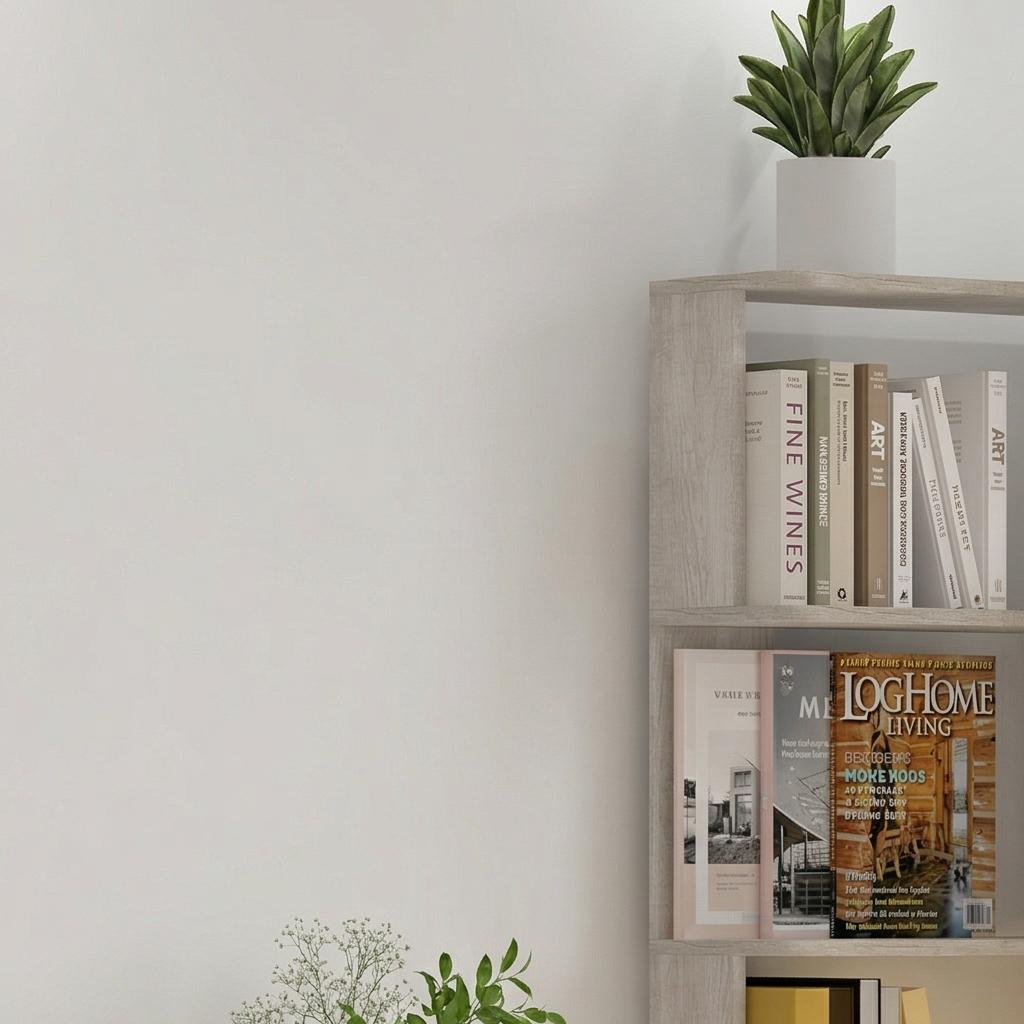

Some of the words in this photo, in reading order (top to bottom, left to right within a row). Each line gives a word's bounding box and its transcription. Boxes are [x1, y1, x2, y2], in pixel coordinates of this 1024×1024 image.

[785, 402, 804, 466] FINE
[870, 420, 886, 461] ART
[991, 427, 1006, 465] ART
[785, 479, 804, 574] WINES
[886, 716, 952, 737] LIVING
